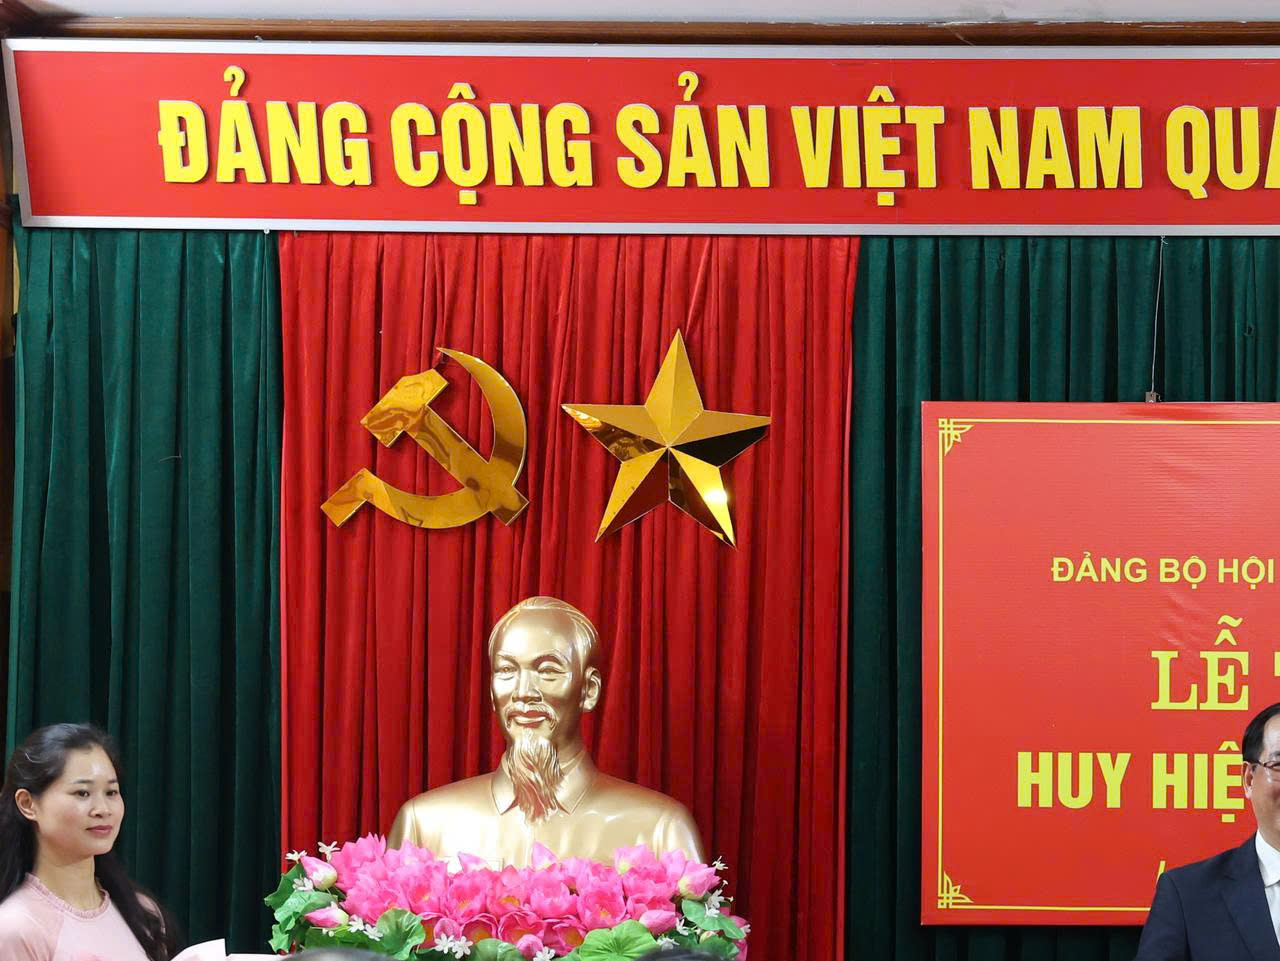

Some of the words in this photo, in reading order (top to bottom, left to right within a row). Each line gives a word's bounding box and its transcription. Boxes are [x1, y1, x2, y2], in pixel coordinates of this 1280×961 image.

[158, 66, 372, 188] ĐẢNG
[391, 83, 594, 206] CỘNG
[616, 71, 771, 190] SẢN
[791, 86, 946, 207] VIỆT
[969, 105, 1143, 191] NAM
[1051, 551, 1149, 584] ĐẢNG
[1159, 556, 1207, 589] BỘ
[1218, 556, 1275, 590] HỘI
[1151, 615, 1251, 712] LỄ
[1017, 752, 1133, 810] HUY
[1153, 741, 1245, 823] HIỆ
